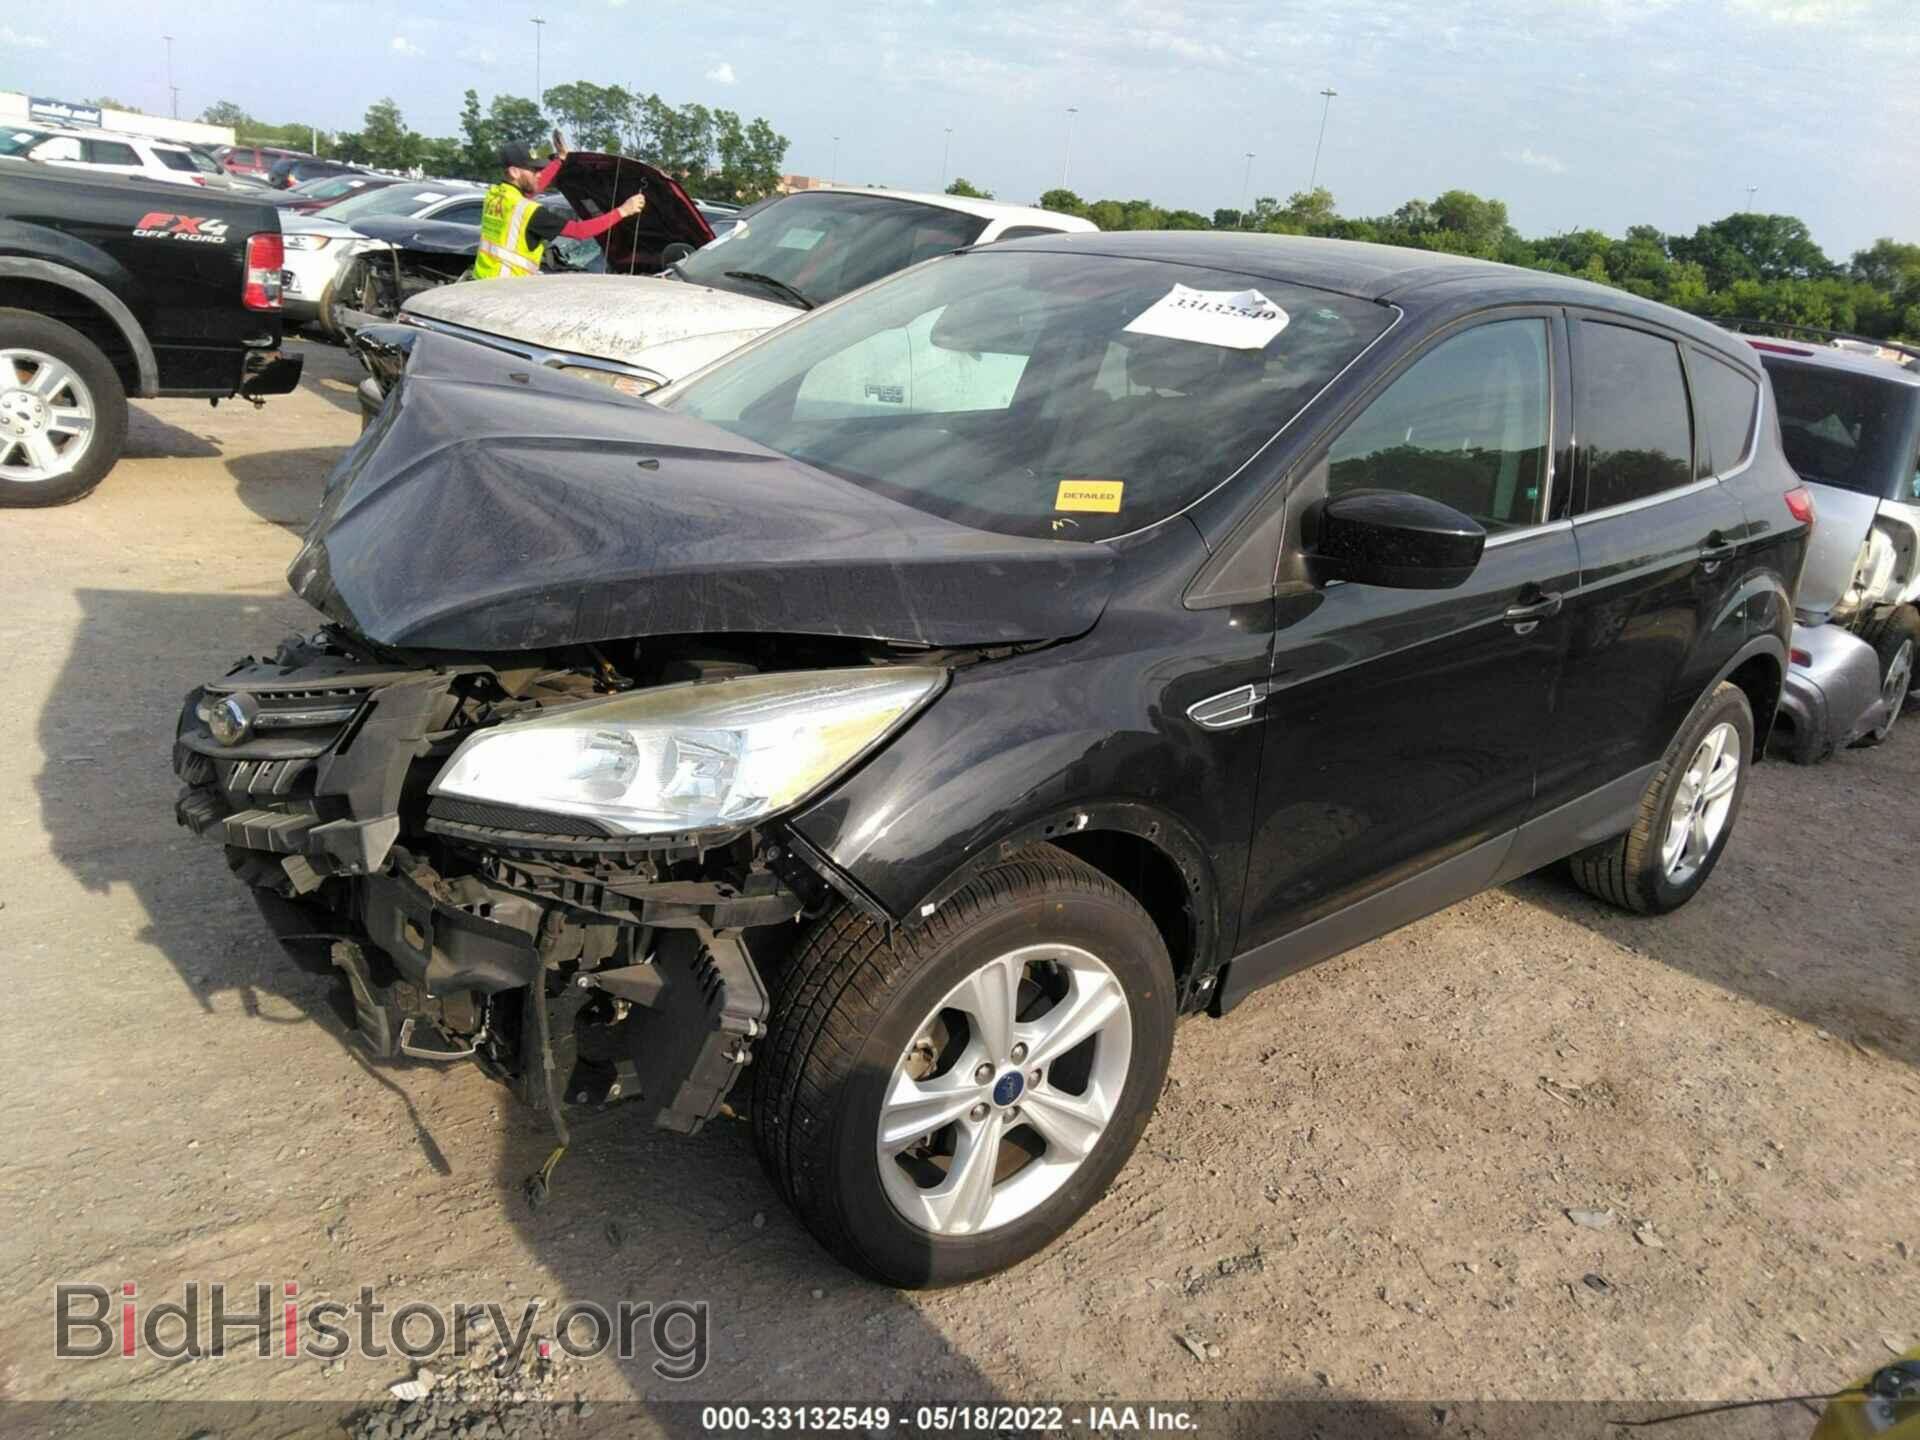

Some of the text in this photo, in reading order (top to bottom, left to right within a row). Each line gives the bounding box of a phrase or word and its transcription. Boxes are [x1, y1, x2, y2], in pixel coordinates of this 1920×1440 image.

[136, 212, 229, 236] FX4
[132, 229, 227, 244] OFF ROAD
[1063, 492, 1115, 501] DETAILED
